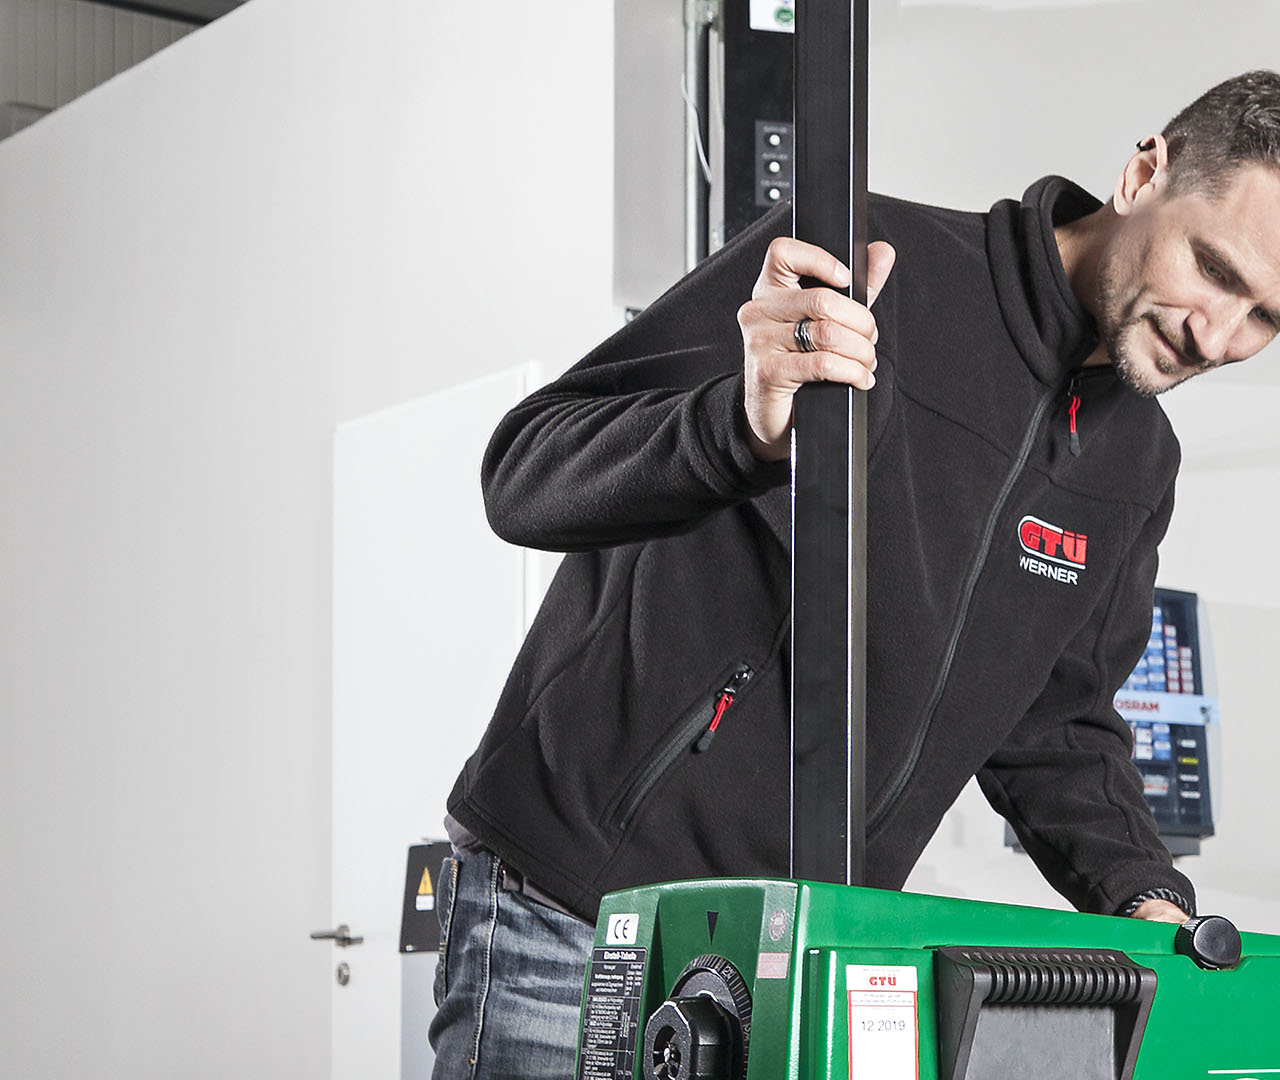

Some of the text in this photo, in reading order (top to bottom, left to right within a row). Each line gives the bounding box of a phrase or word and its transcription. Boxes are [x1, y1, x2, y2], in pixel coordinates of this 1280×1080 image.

[1020, 520, 1088, 564] GTÜ
[1019, 555, 1079, 586] WERNER
[1113, 698, 1159, 712] OSRAM
[613, 919, 630, 939] CE
[869, 973, 897, 987] GTÜ
[877, 1020, 906, 1032] 2019
